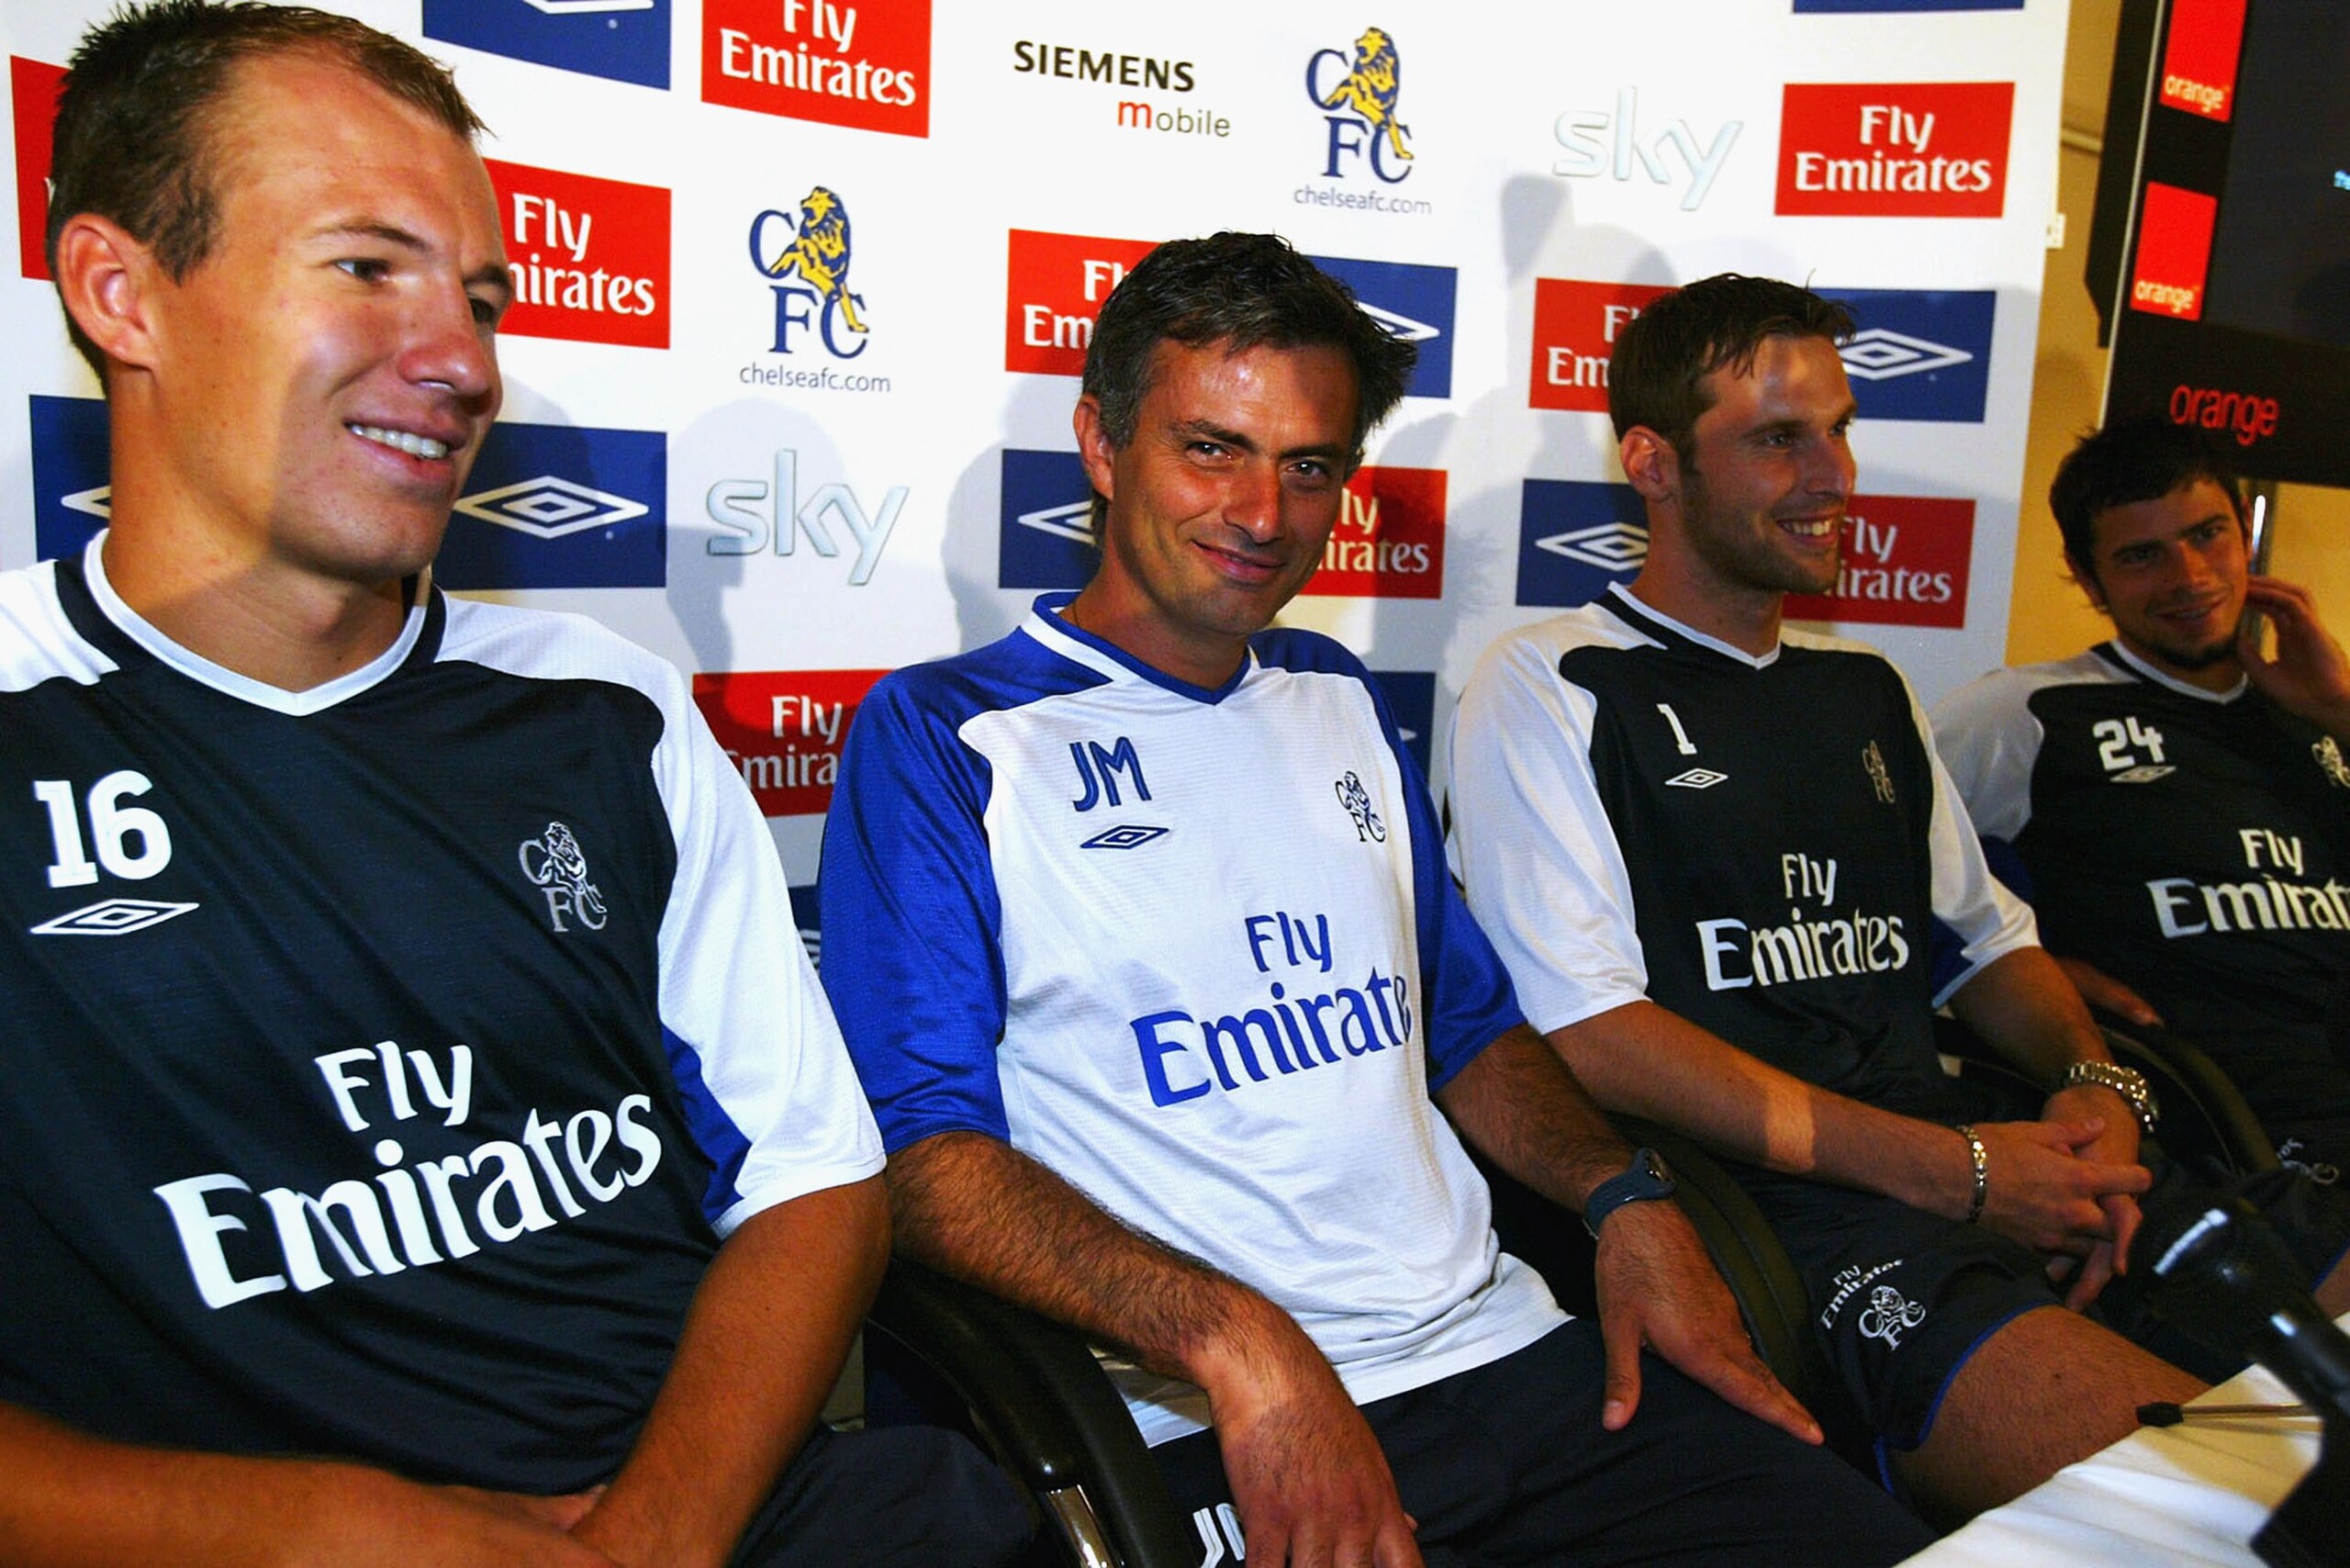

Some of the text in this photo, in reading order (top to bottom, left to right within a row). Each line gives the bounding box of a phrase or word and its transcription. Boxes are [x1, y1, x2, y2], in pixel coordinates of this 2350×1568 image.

[721, 28, 916, 106] Emirates
[1013, 40, 1195, 93] SIEMENS
[2165, 74, 2224, 113] orange
[1117, 100, 1231, 138] mobile
[1860, 106, 1936, 153] Fly
[1552, 85, 1745, 212] sky
[1796, 150, 1993, 192] Emirates
[1293, 185, 1433, 215] chelseafc.com
[512, 193, 592, 263] Fly
[1083, 259, 1131, 302] Fl
[2134, 279, 2194, 313] orange
[739, 363, 891, 393] chelseafc.com
[2169, 384, 2280, 446] orange
[706, 447, 911, 587] sky
[1317, 530, 1430, 574] irates
[1824, 559, 1953, 603] irates
[771, 695, 843, 745] Fly
[1655, 702, 1698, 756] 1
[2092, 716, 2166, 771] 24
[726, 744, 840, 790] mira
[1069, 736, 1153, 812] JM
[34, 769, 173, 889] 16
[2239, 828, 2304, 876] Fly
[1782, 852, 1837, 906] Fly
[2144, 876, 2350, 940] Emirat
[1245, 911, 1333, 973] Fly
[1695, 906, 1909, 991] Emirates
[1129, 965, 1412, 1108] Emirate
[315, 1039, 473, 1133] Fly
[153, 1093, 663, 1310] Emirates
